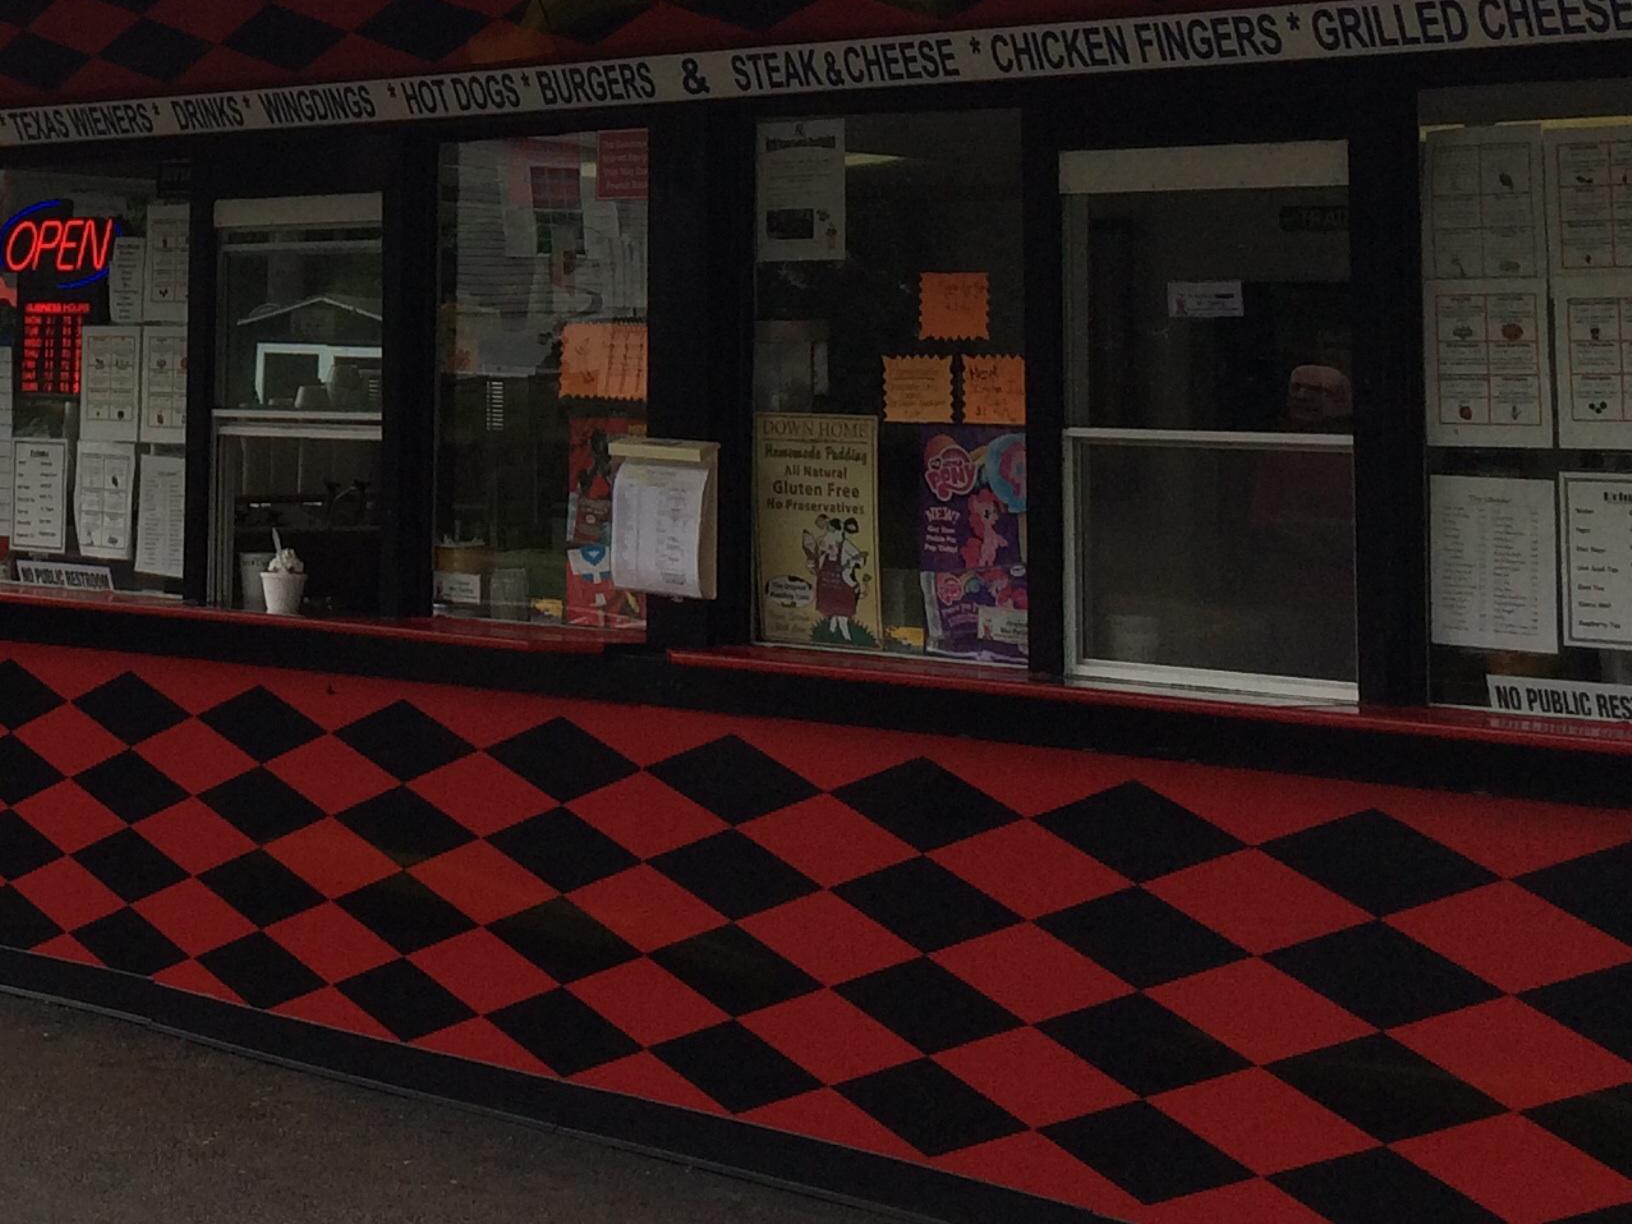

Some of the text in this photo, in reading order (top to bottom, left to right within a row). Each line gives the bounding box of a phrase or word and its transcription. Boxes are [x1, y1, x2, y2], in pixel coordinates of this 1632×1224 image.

[9, 110, 69, 141] TEXAS
[69, 103, 154, 137] WIENERS
[171, 96, 244, 130] DRINKS
[259, 85, 376, 124] WINGDINGS
[401, 78, 450, 114] HOT
[451, 72, 520, 110] DOGS
[536, 62, 656, 105] BURGERS
[682, 58, 710, 94] &
[991, 25, 1129, 73] CHICKEN
[1134, 13, 1282, 63] FINGERS
[1311, 0, 1469, 51] GRILLED
[4, 217, 114, 272] OPEN
[764, 420, 864, 437] DOWN HOME
[825, 446, 867, 465] Pudding
[784, 465, 847, 479] All Natural
[773, 480, 860, 497] Gluten Free
[766, 497, 865, 514] No Preservatives
[1495, 686, 1521, 710] NO
[1526, 688, 1592, 716] PUBLIC
